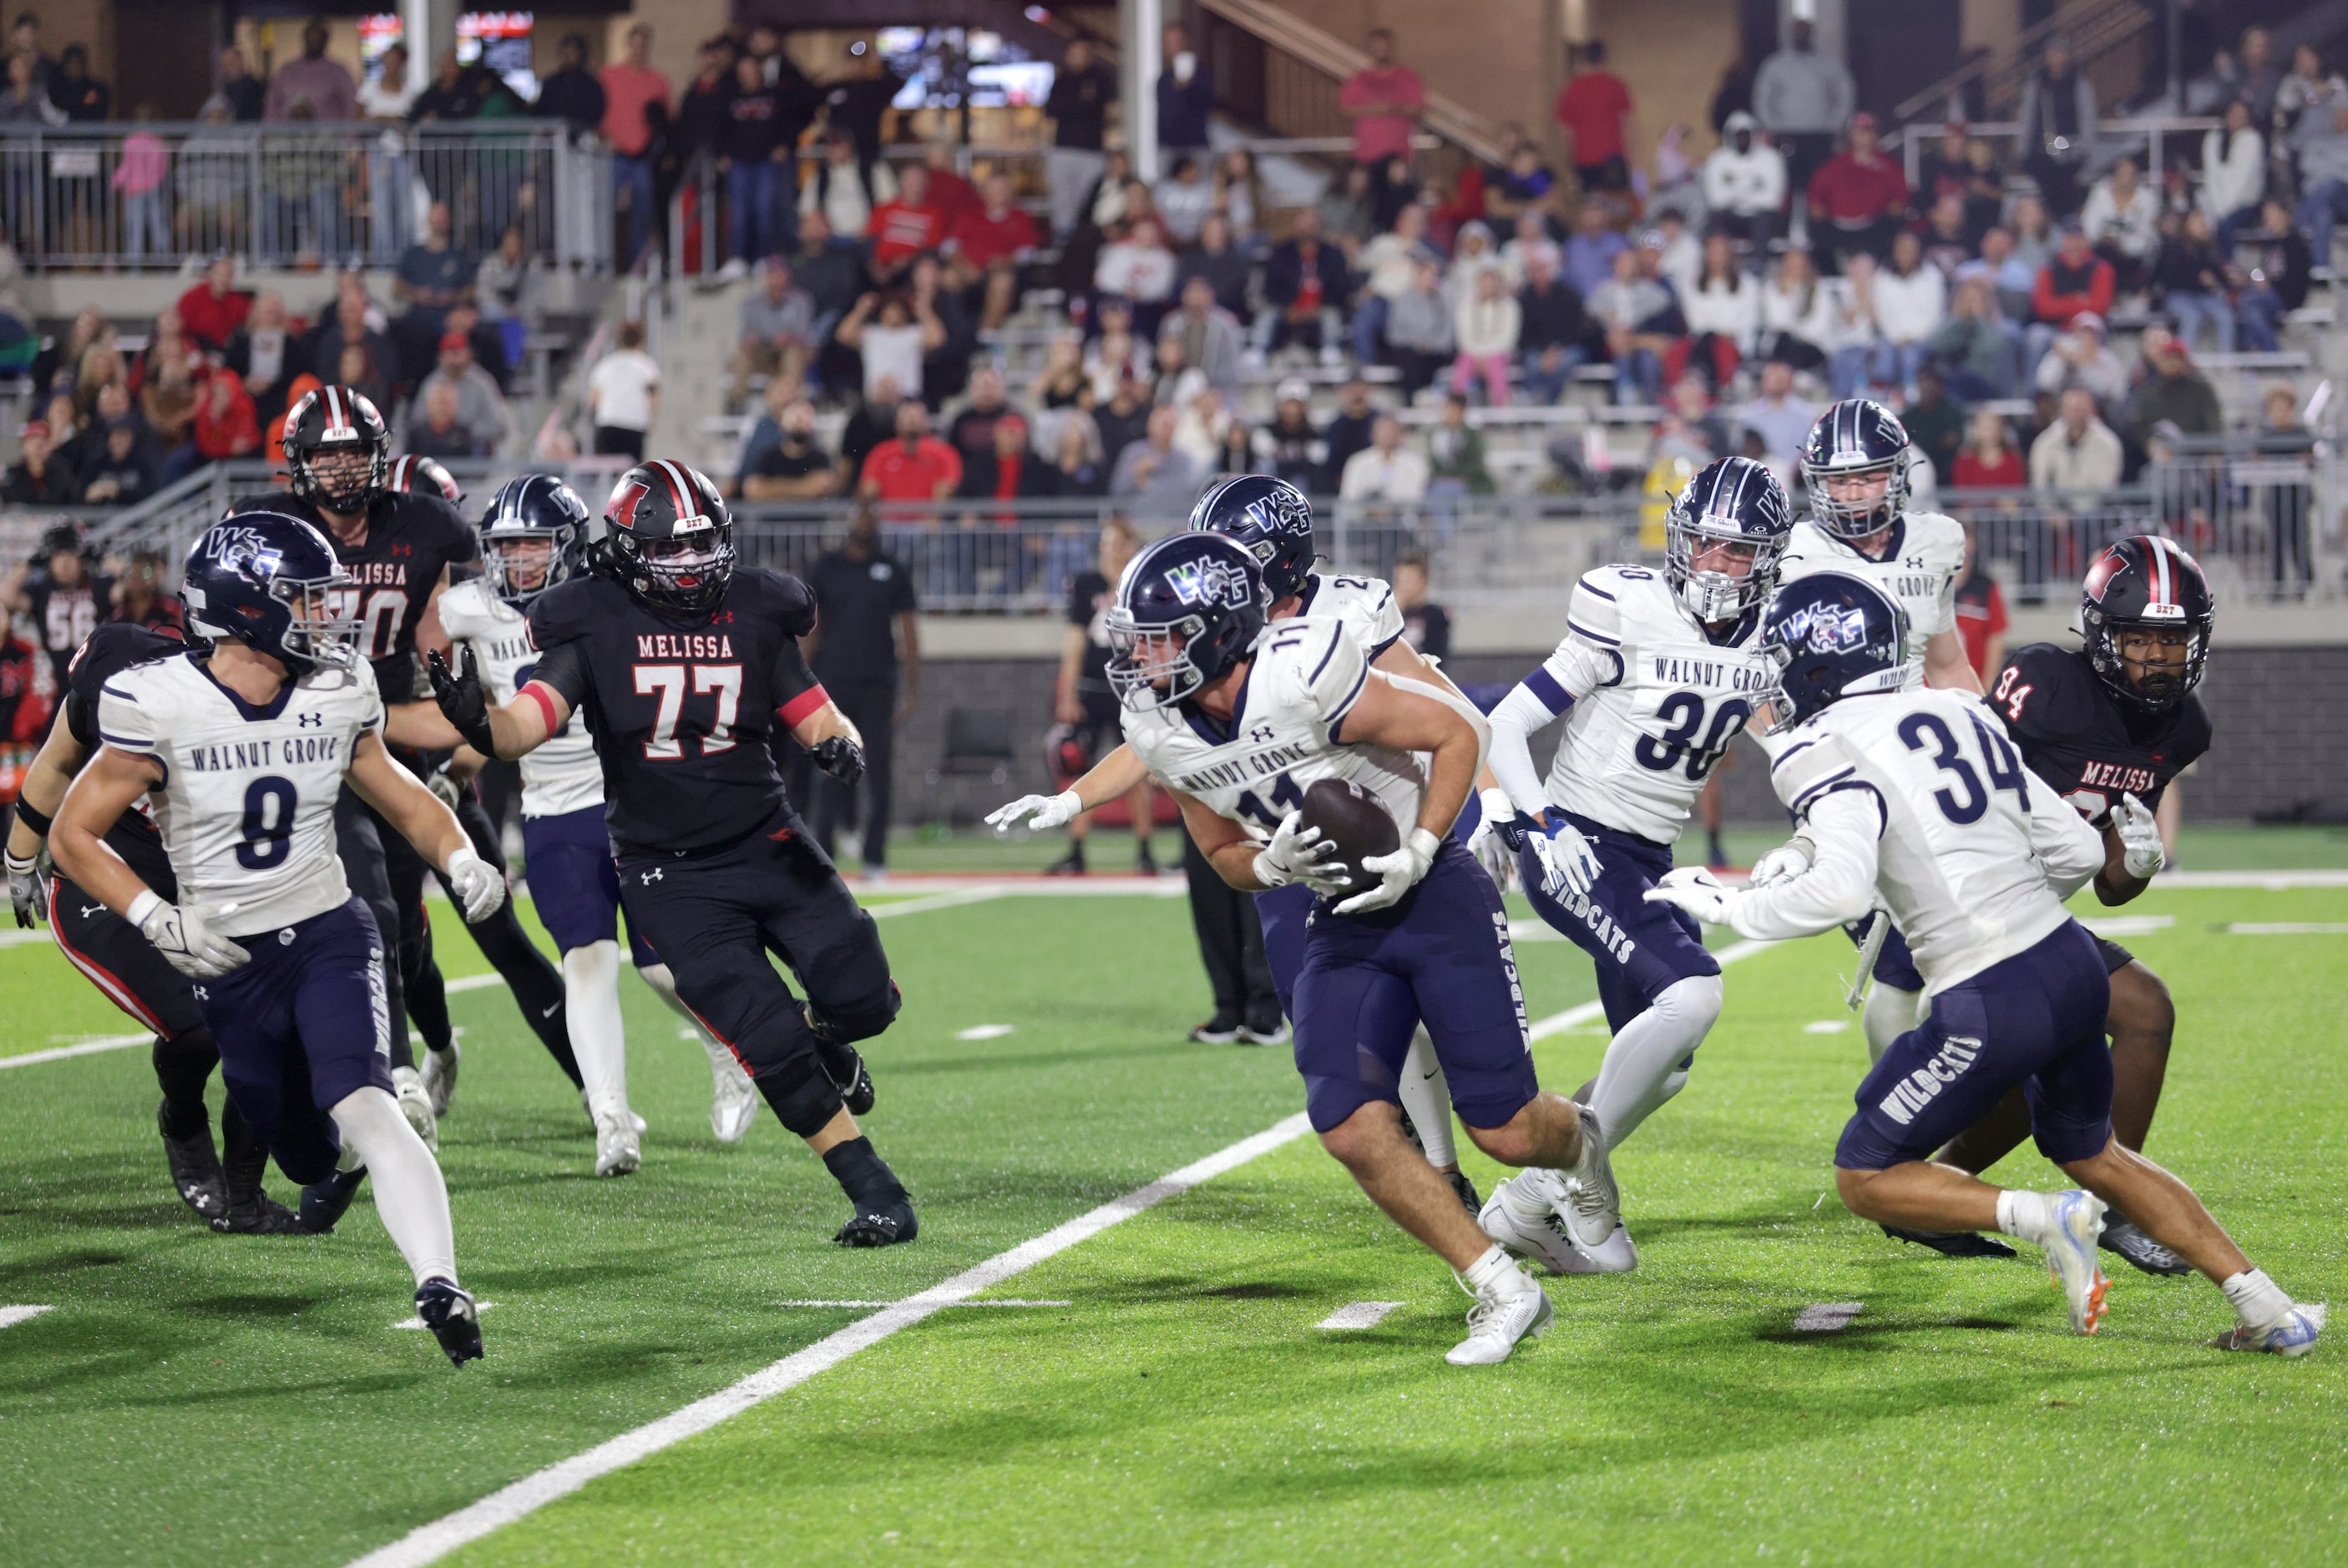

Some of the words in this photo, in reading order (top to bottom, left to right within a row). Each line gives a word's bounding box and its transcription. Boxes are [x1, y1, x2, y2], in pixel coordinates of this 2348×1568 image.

[490, 637, 528, 661] WALN
[637, 635, 733, 658] MELISSA
[1656, 657, 1723, 688] WALNUT
[1994, 665, 2033, 722] 84
[632, 664, 744, 761] 77
[1634, 691, 1752, 781] 30
[191, 741, 271, 771] WALNUT
[283, 736, 337, 766] GROVE
[1179, 760, 1248, 792] WALNUT
[1249, 742, 1310, 775] GROVE
[1898, 709, 2031, 826] 34
[2080, 759, 2156, 792] MELISSA
[1880, 1036, 1982, 1125] WILDCATS
